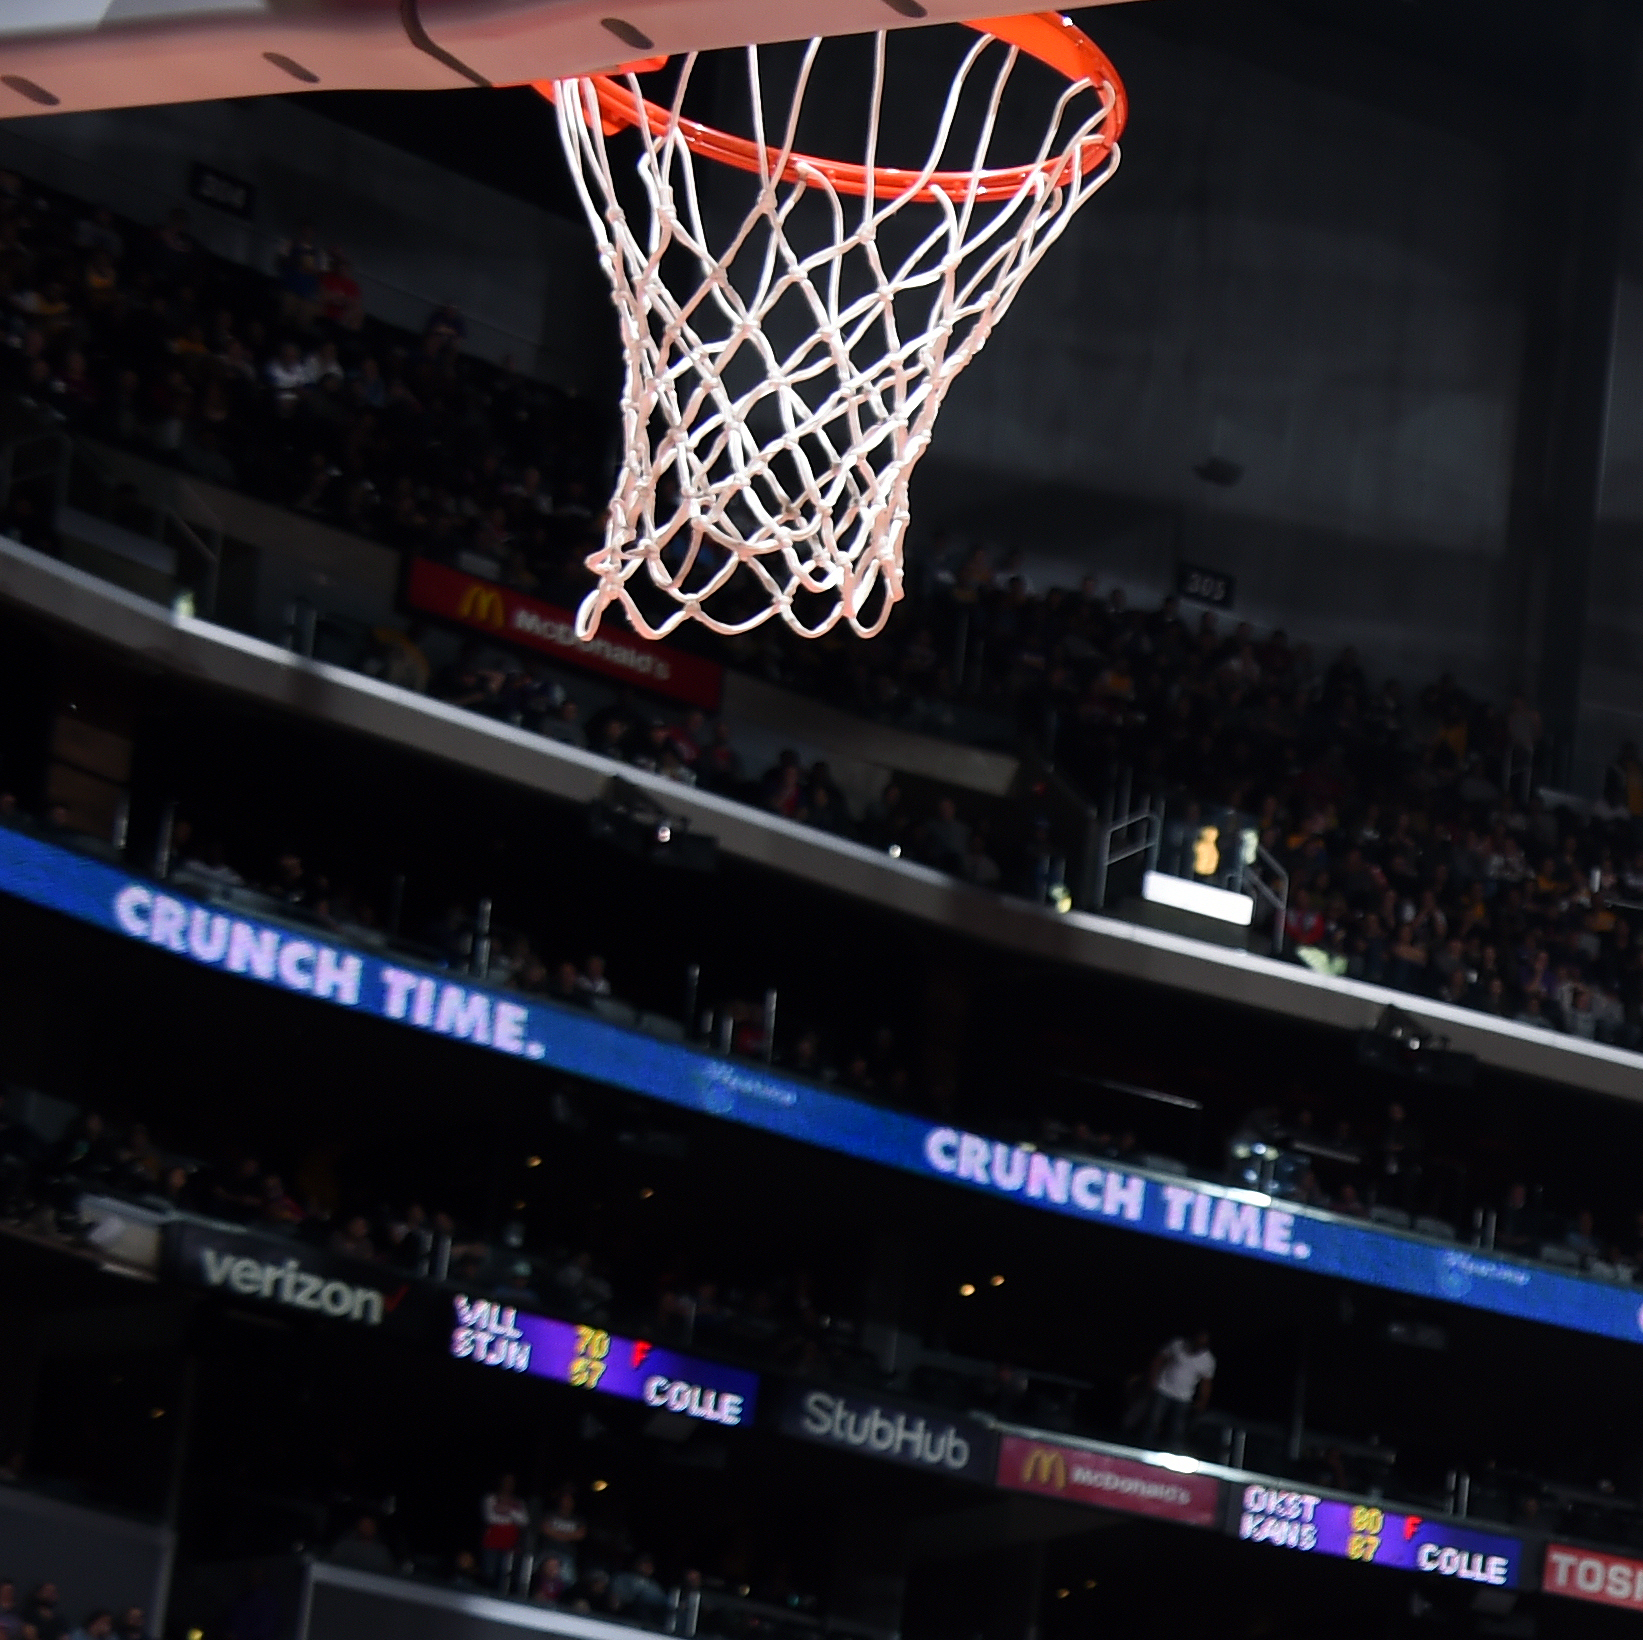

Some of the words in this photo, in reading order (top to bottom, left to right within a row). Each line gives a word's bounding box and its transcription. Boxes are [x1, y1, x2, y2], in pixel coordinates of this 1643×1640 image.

[115, 884, 362, 1006] CRUNCH
[381, 967, 546, 1060] TIME.
[925, 1126, 1146, 1221] CRUNCH
[1163, 1185, 1312, 1260] TIME.
[203, 1248, 384, 1325] verizon
[803, 1391, 970, 1470] StubHub
[1073, 1465, 1191, 1506] McDonald's
